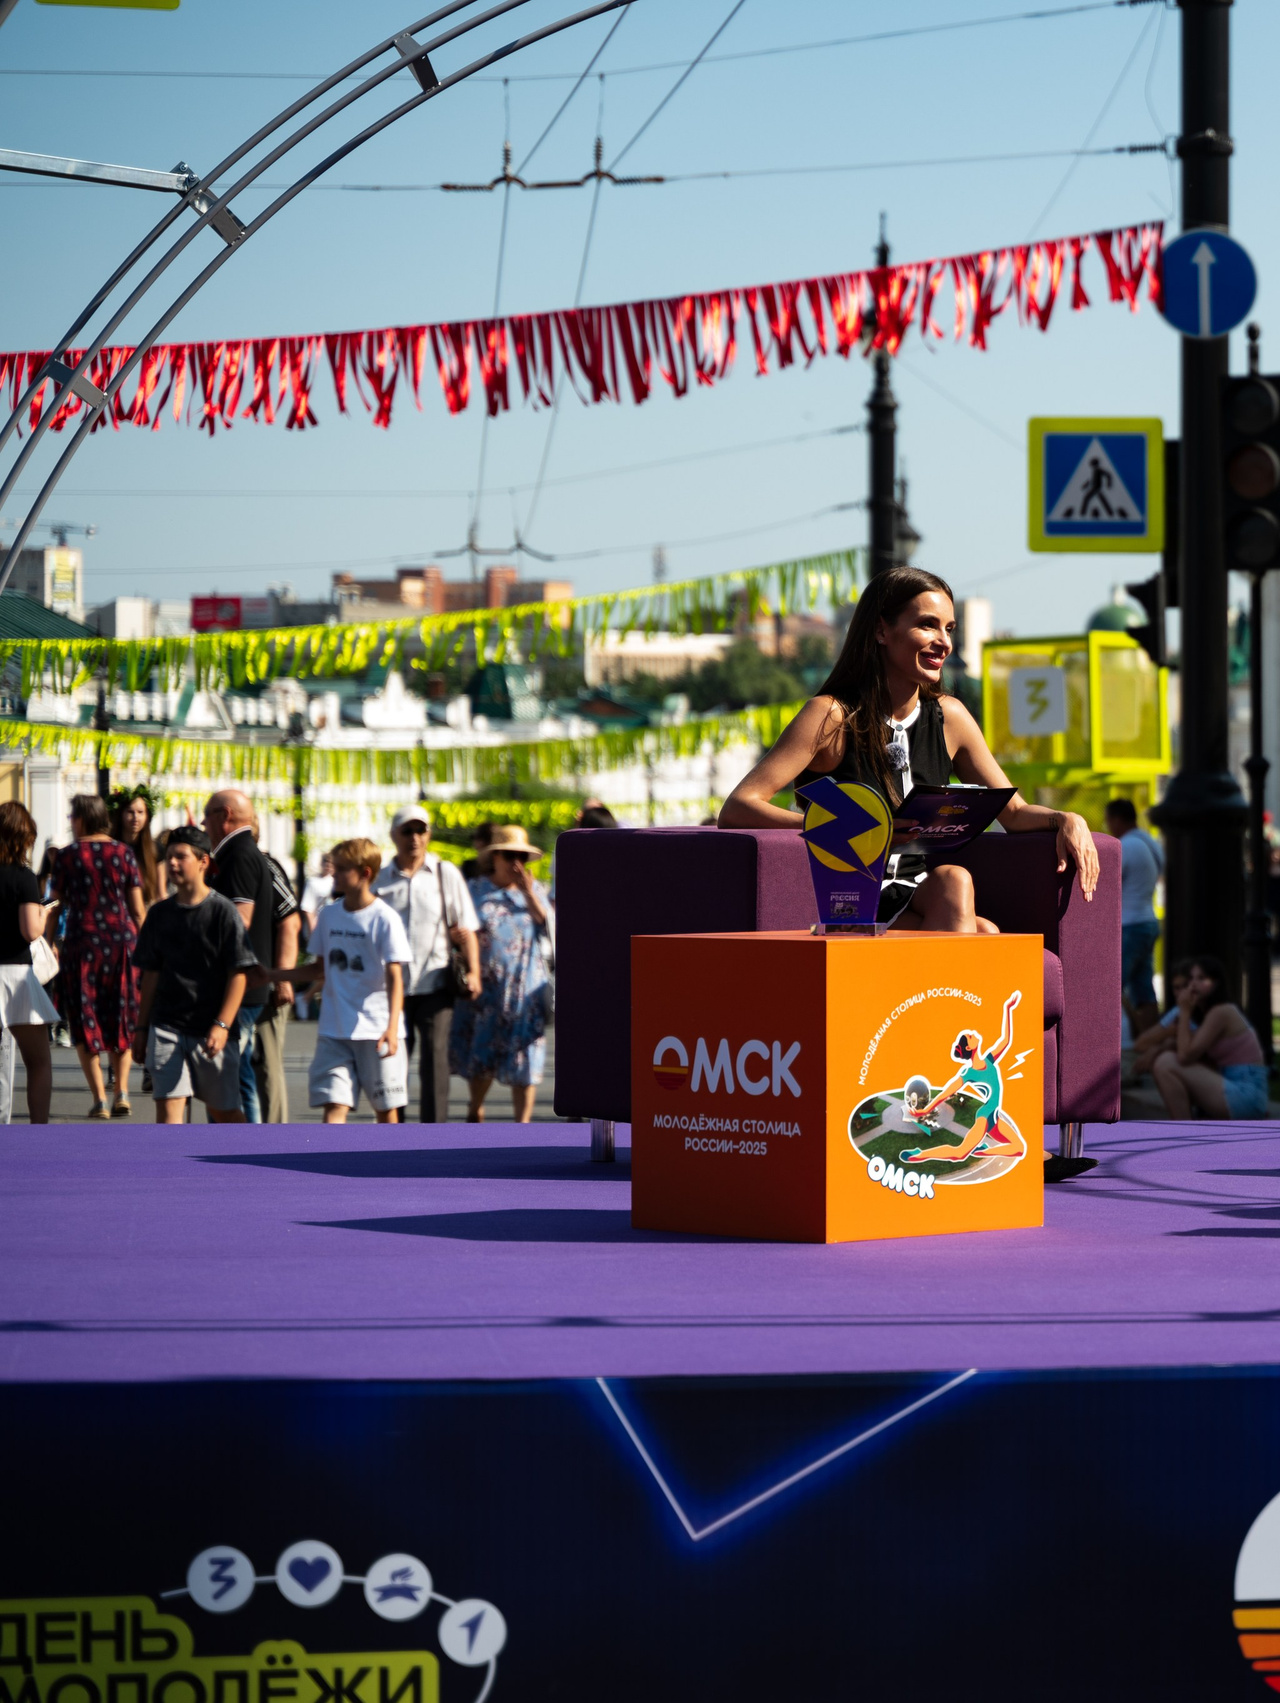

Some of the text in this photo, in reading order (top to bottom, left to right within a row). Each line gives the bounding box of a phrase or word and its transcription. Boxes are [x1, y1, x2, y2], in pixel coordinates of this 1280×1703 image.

[857, 987, 982, 1086] МОЛОДЁЖНАЯ СТОЛИЦА РОССИИ-2025
[653, 1035, 802, 1098] ОМСК
[653, 1113, 802, 1138] МОЛОДЁЖНАЯ СТОЛИЦА
[685, 1137, 768, 1156] РОССИИ-2025
[867, 1156, 935, 1199] ОМСК
